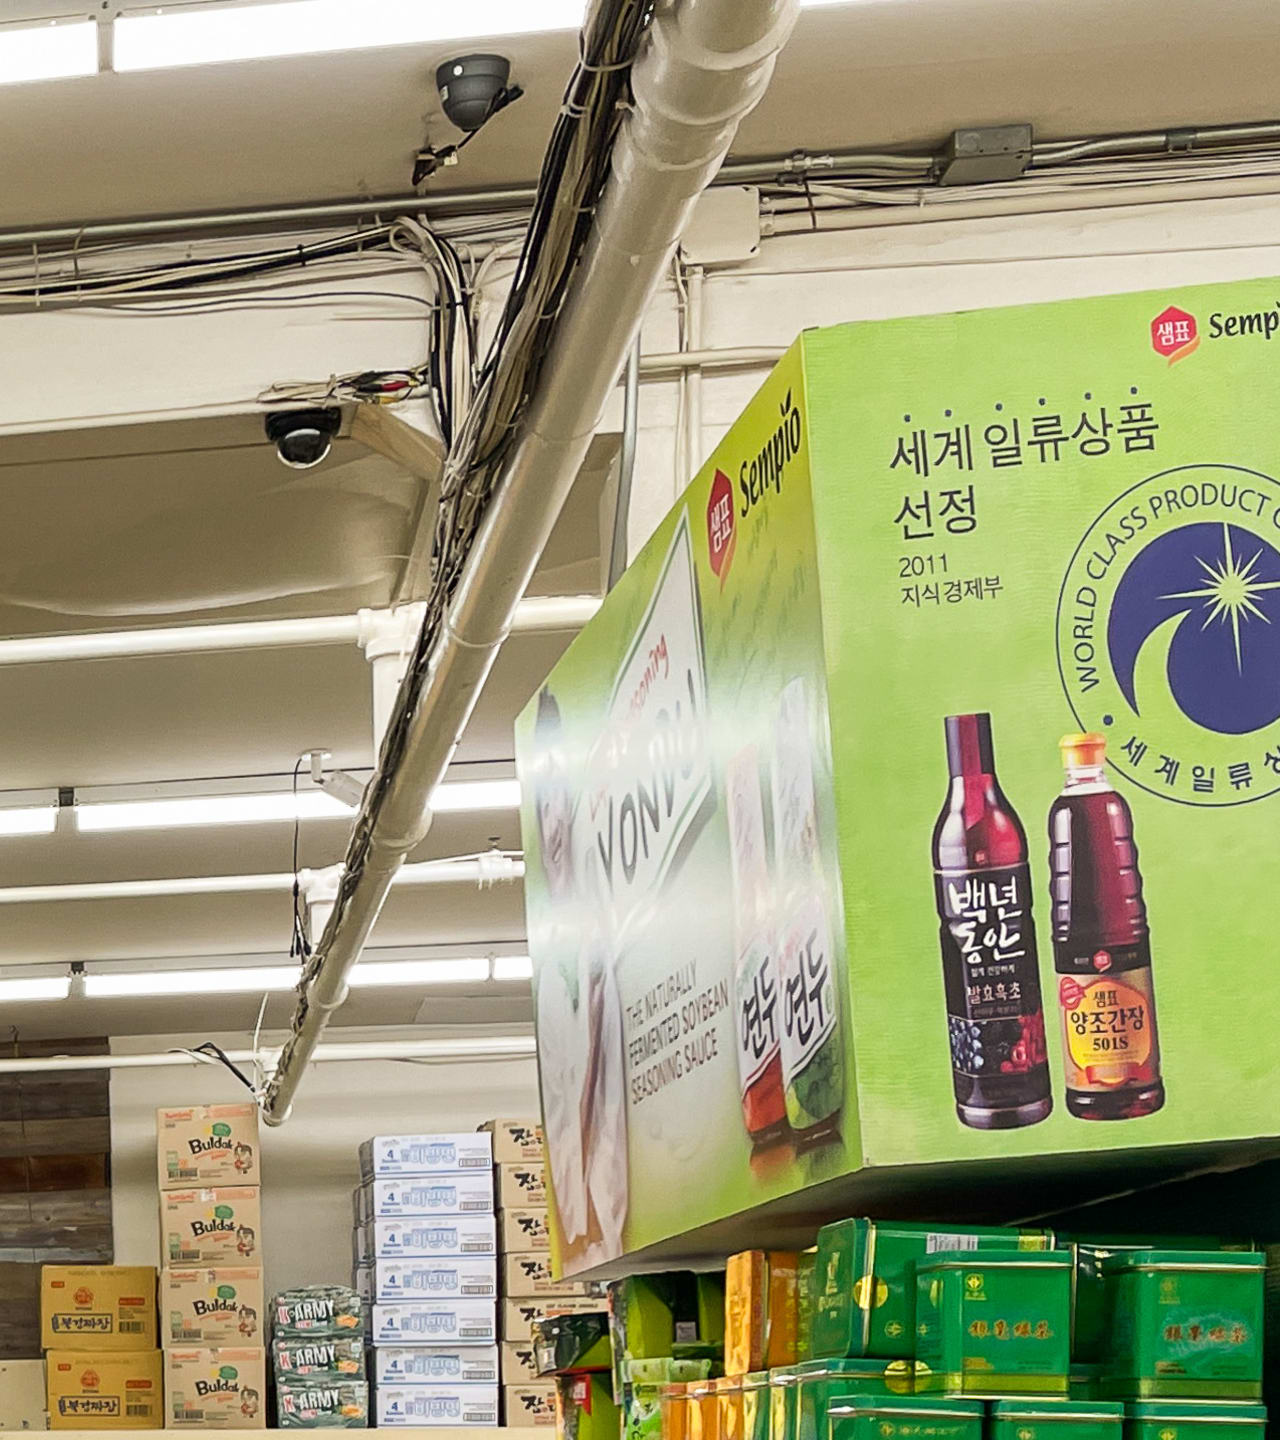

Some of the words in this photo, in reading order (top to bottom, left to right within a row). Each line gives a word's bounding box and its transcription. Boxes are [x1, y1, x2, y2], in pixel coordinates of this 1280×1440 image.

[1157, 320, 1190, 346] 샘표
[740, 386, 801, 518] Sempio
[710, 493, 732, 553] 샘표
[894, 484, 977, 541] 선정
[1149, 483, 1272, 519] PRODUCT
[899, 552, 949, 578] 2011
[1086, 505, 1148, 580] CLASS
[1073, 586, 1100, 693] WORLD
[948, 876, 1023, 924] 백년
[950, 922, 1026, 965] 동안
[627, 999, 643, 1031] THE
[645, 958, 697, 1021] NATURALLY
[744, 956, 778, 1060] 연두
[785, 928, 829, 1046] 연두
[969, 982, 1021, 1004] 발효흑초
[1093, 991, 1120, 1007] 샘표
[629, 1013, 680, 1069] FERMENTED
[682, 977, 730, 1035] SOYBEAN
[1070, 1005, 1144, 1034] 양조간장
[1093, 1036, 1128, 1051] 501S
[631, 1050, 683, 1105] SEASONING
[684, 1027, 718, 1073] SAUCE
